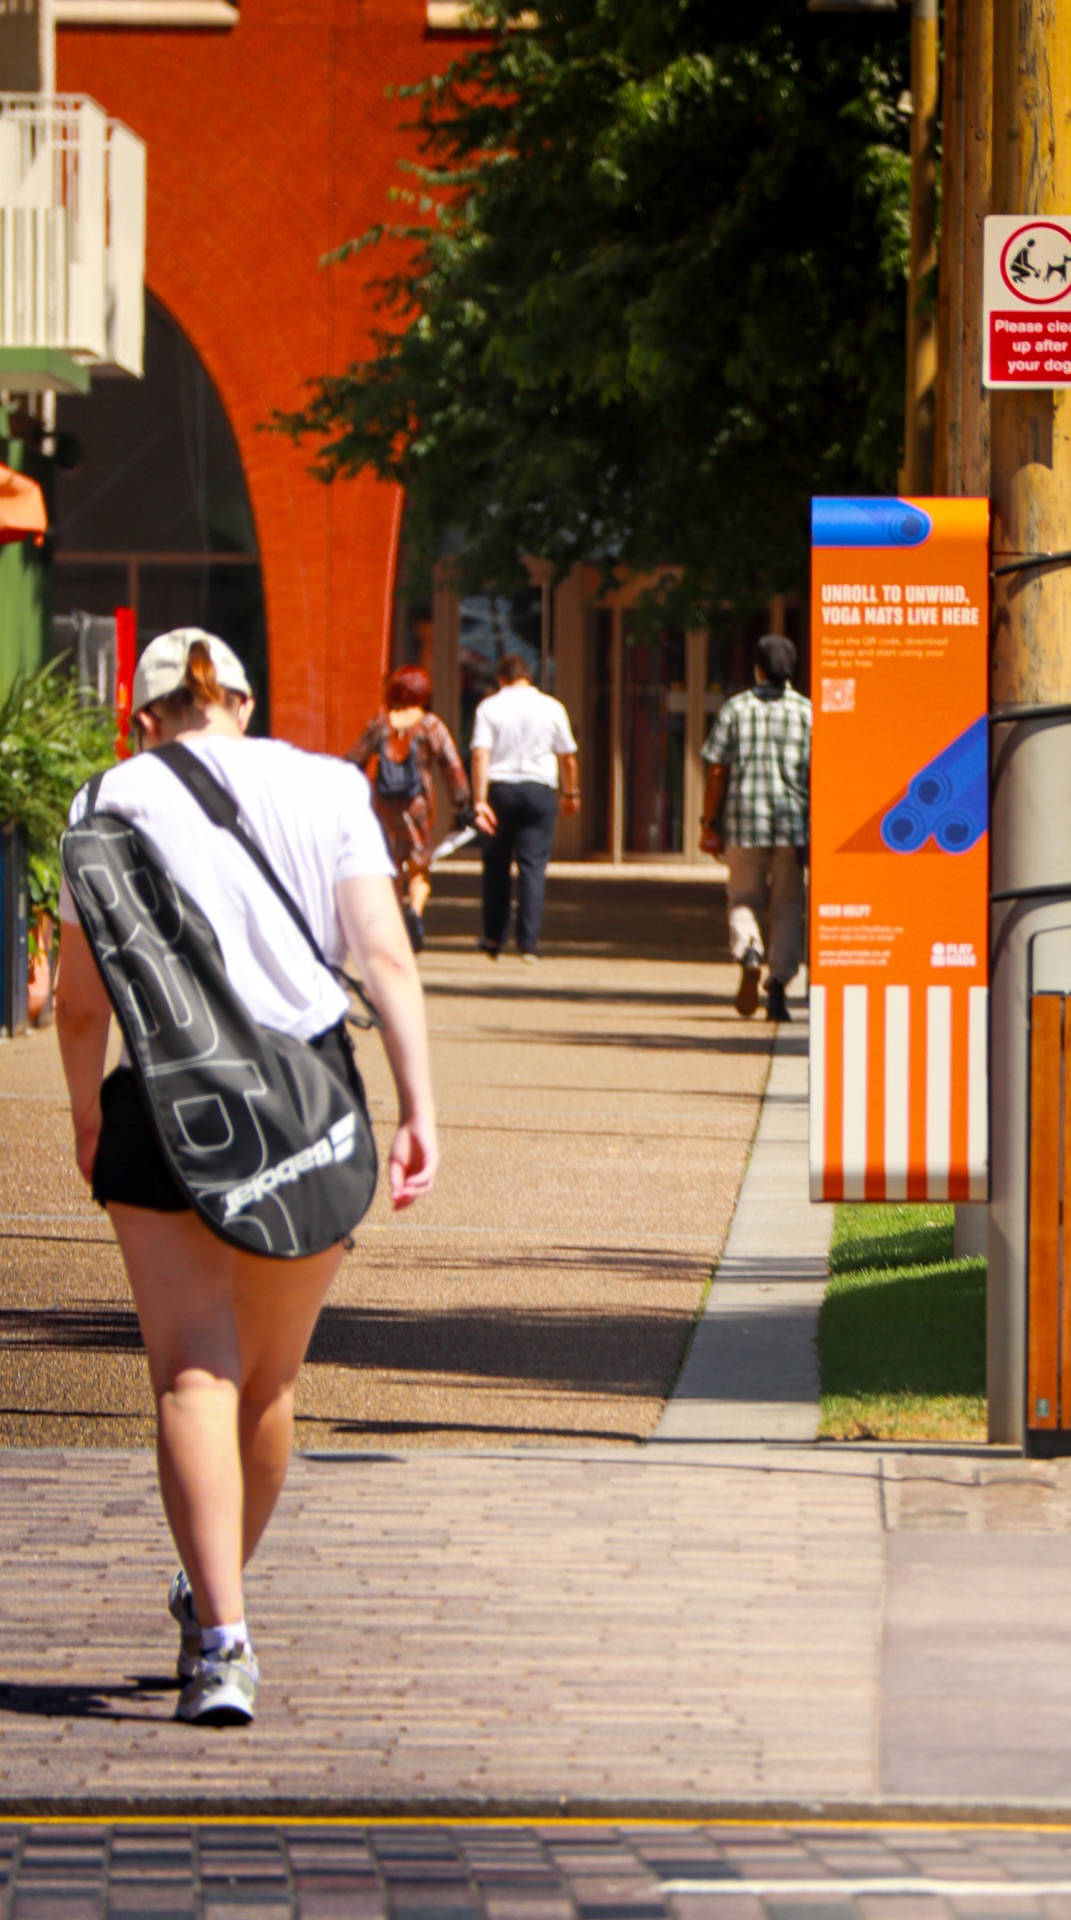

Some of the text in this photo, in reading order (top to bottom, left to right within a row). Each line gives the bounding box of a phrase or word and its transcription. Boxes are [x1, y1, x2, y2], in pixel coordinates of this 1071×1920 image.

[994, 319, 1044, 333] Please
[1012, 338, 1068, 355] up after
[1007, 358, 1071, 375] your dog
[821, 584, 971, 606] UNROLL TO UNWIND,
[821, 606, 979, 626] YOGA MATS LIVE HERE
[845, 636, 861, 646] the
[862, 636, 876, 647] QR
[904, 637, 948, 646] download
[821, 648, 836, 657] the
[838, 649, 855, 658] app
[857, 648, 874, 657] and
[818, 904, 871, 917] NEED HELP?
[946, 943, 974, 955] PLAY
[946, 954, 977, 967] MADE
[224, 1136, 334, 1218] Babolat
